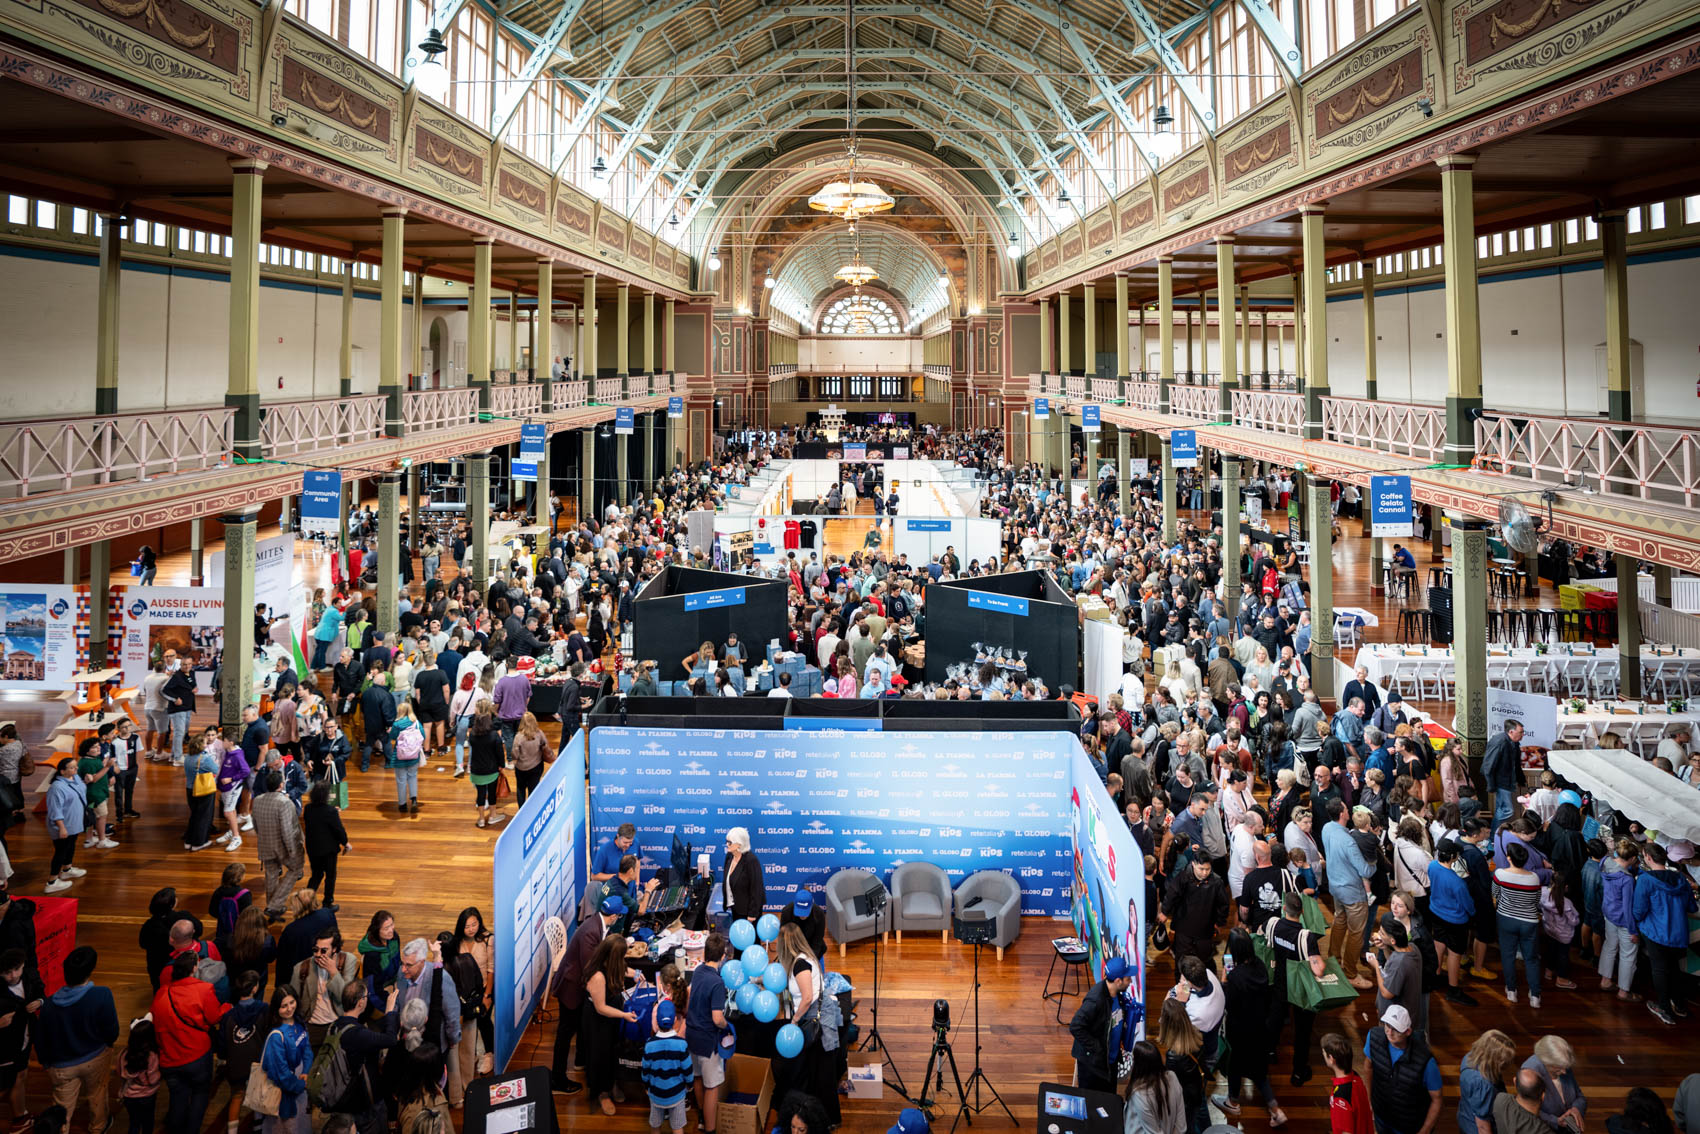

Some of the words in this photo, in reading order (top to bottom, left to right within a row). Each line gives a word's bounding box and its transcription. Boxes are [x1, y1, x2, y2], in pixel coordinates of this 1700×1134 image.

[304, 490, 339, 498] Community
[256, 545, 284, 561] MITES
[150, 599, 189, 608] AUSSIE
[1492, 706, 1524, 716] puopolo
[525, 832, 533, 850] IL
[533, 798, 555, 836] GLOBO
